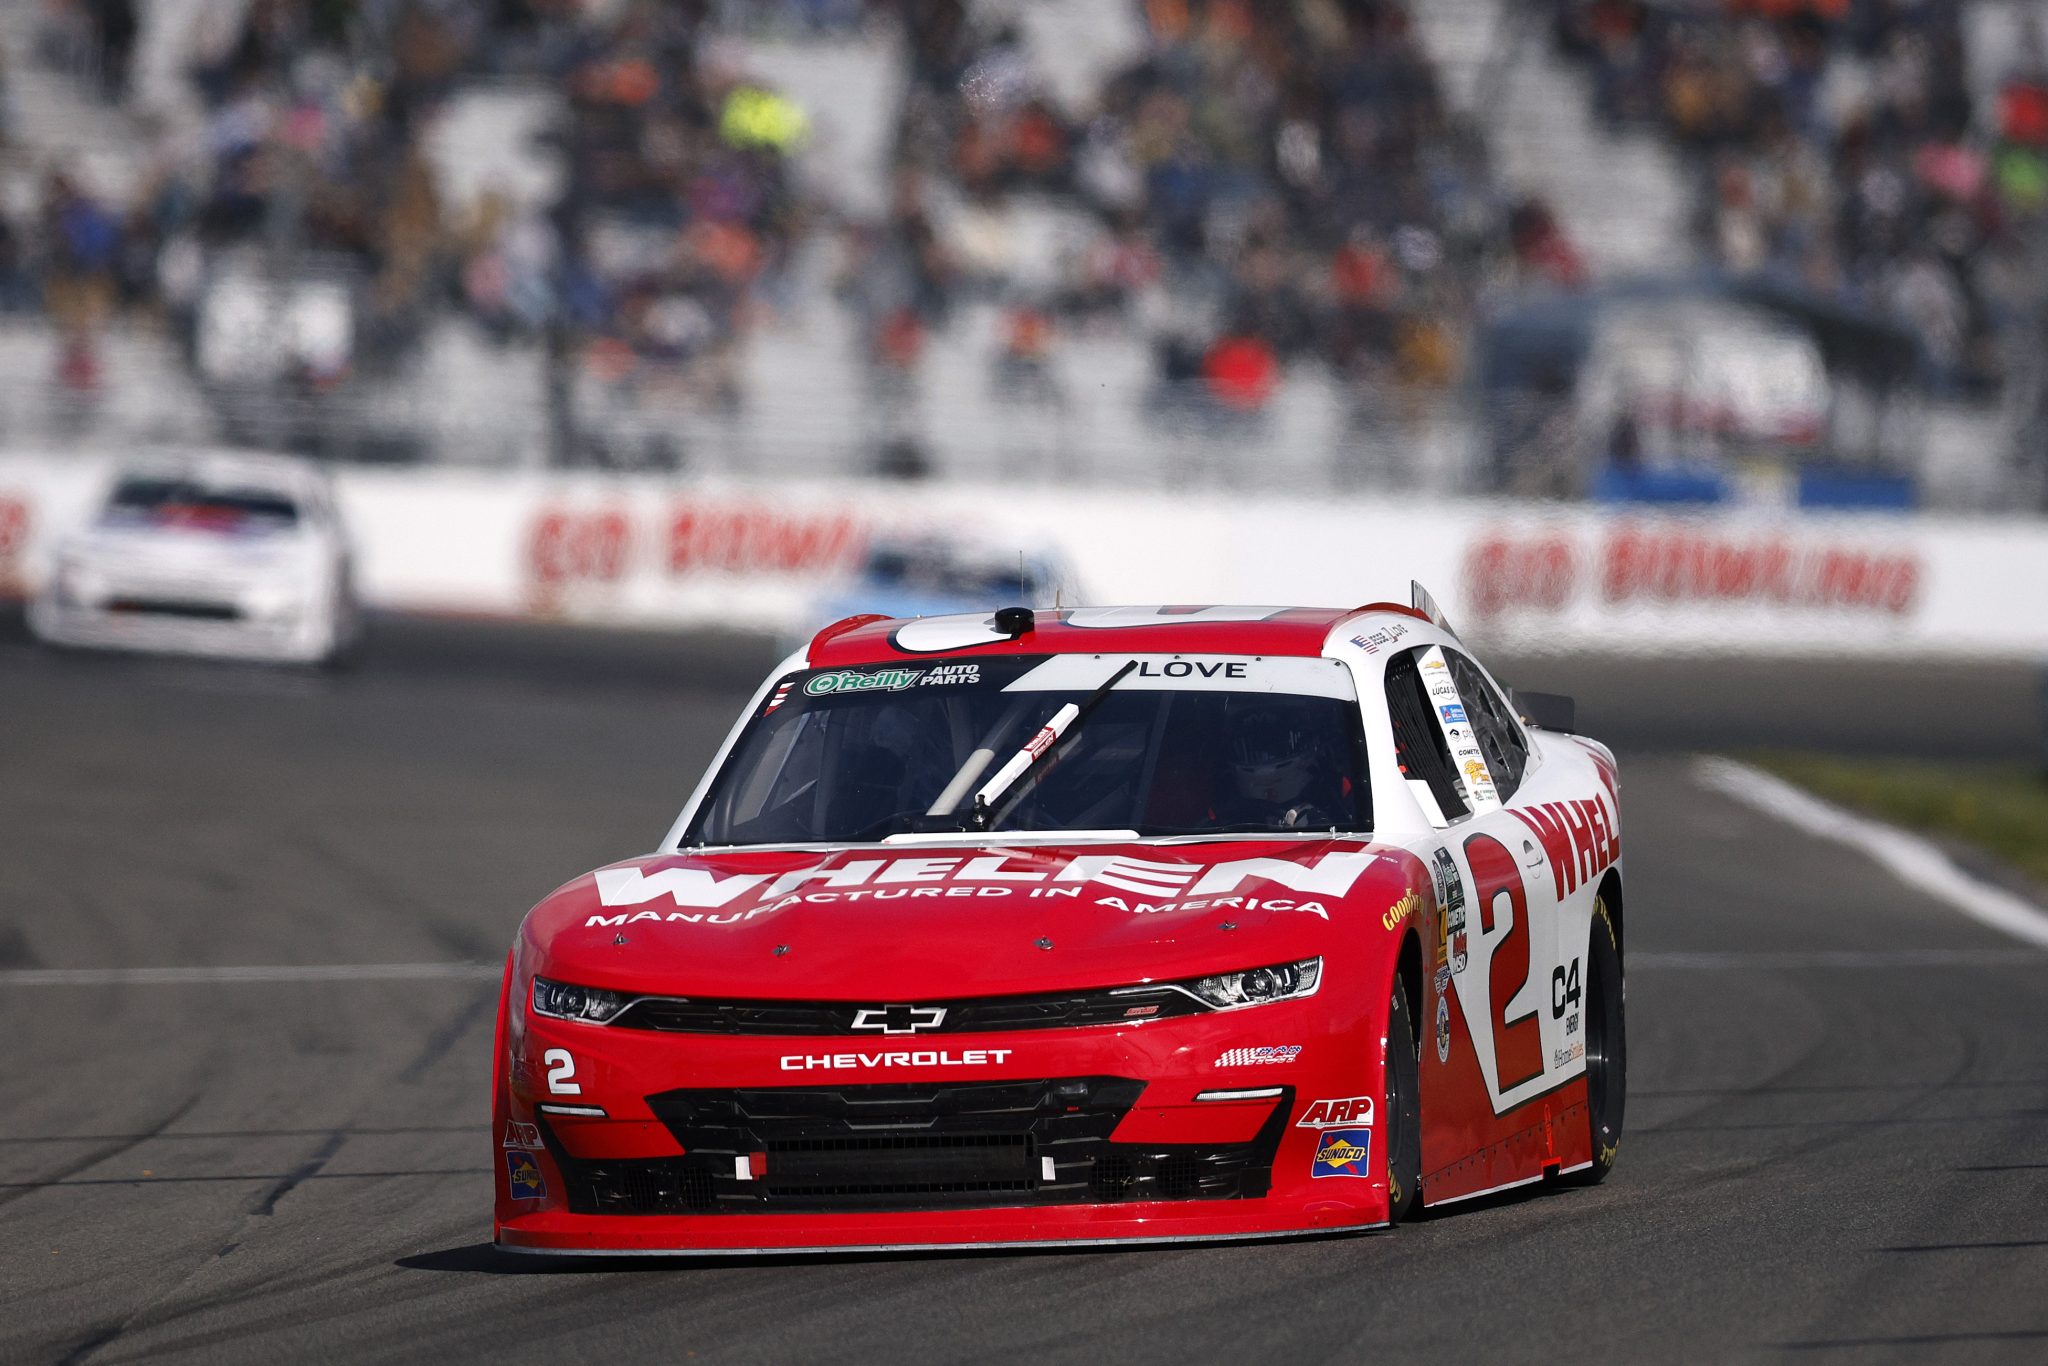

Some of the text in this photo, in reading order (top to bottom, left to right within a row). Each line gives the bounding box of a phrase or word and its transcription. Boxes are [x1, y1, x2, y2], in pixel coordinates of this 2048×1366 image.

[806, 669, 921, 694] O'Reilly
[920, 673, 980, 686] PARTS
[930, 664, 980, 675] AUTO
[1139, 660, 1248, 679] LOVE
[1432, 686, 1450, 696] LUCAS
[593, 850, 1380, 908] WHELEN
[585, 886, 1330, 927] MANUFACTURED IN AMERICA
[1462, 832, 1545, 1096] 2
[1551, 956, 1581, 1020] C4
[544, 1048, 581, 1095] 2
[780, 1049, 1012, 1071] CHEVROLET
[1300, 1098, 1372, 1122] ARP
[1318, 1147, 1364, 1160] SUNOCO
